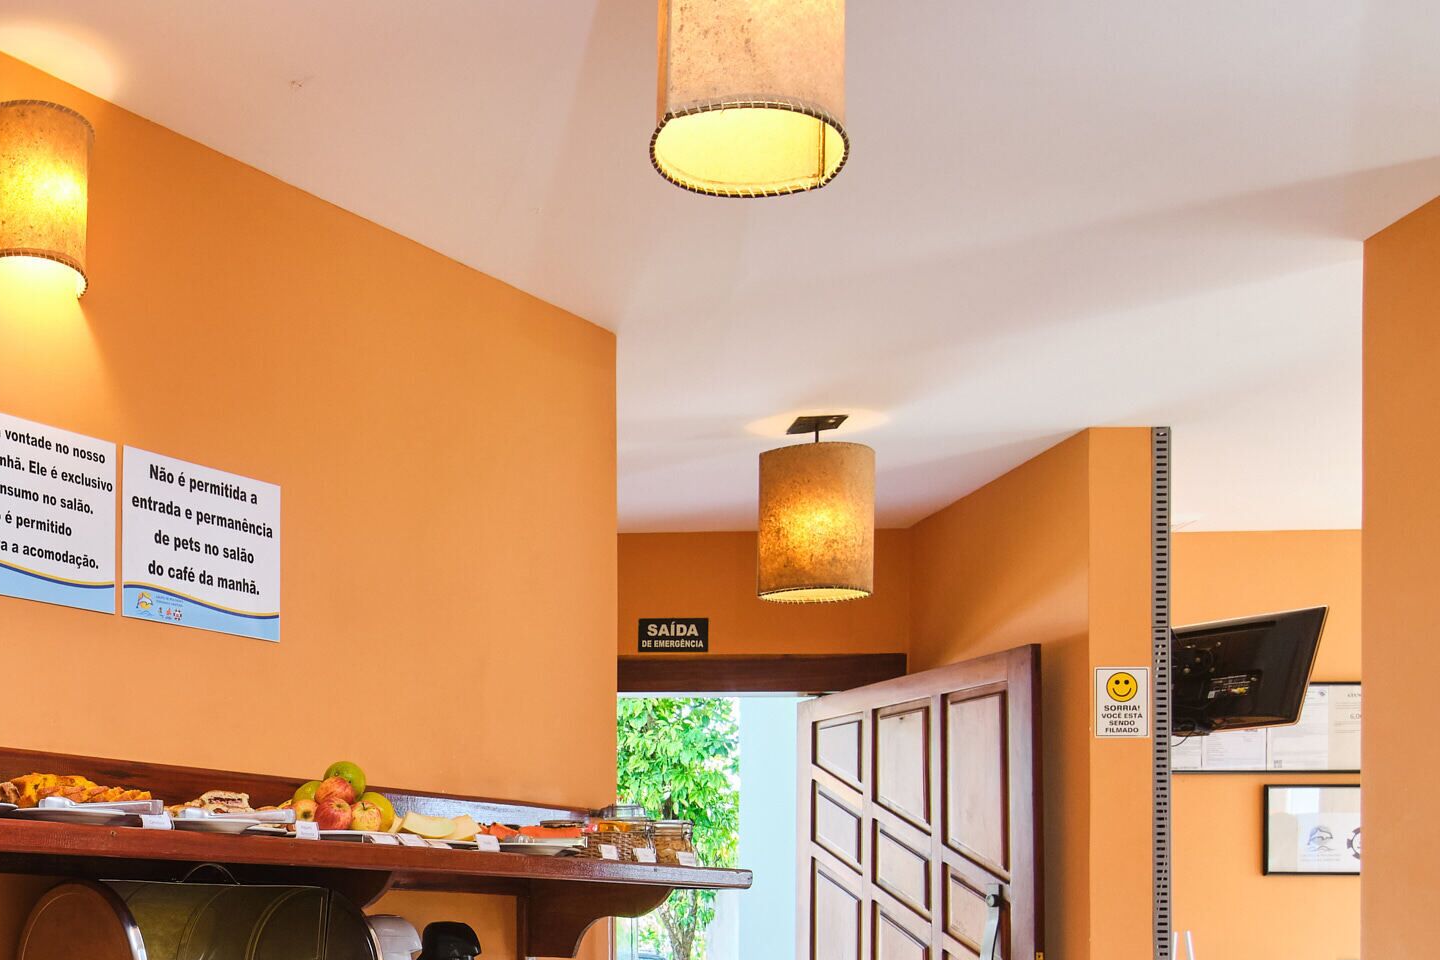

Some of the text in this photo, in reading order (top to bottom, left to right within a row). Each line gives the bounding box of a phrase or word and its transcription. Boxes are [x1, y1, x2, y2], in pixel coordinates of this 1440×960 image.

[4, 429, 52, 451] vontade
[55, 442, 70, 455] no
[72, 447, 106, 464] nosso
[28, 459, 48, 477] Ele
[50, 465, 58, 479] é
[60, 471, 113, 493] exclusivo
[149, 463, 258, 505] Não é permitida a
[42, 494, 57, 506] no
[60, 497, 94, 515] salão.
[131, 495, 273, 539] entrada e permanência
[4, 509, 13, 524] é
[16, 515, 72, 537] permitido
[11, 543, 19, 554] a
[22, 545, 99, 570] acomodação.
[154, 529, 255, 564] de pets no salão
[148, 559, 260, 596] do café da manhã.
[641, 638, 704, 648] DE EMERGÊNCIA
[646, 621, 699, 637] SAÍDA
